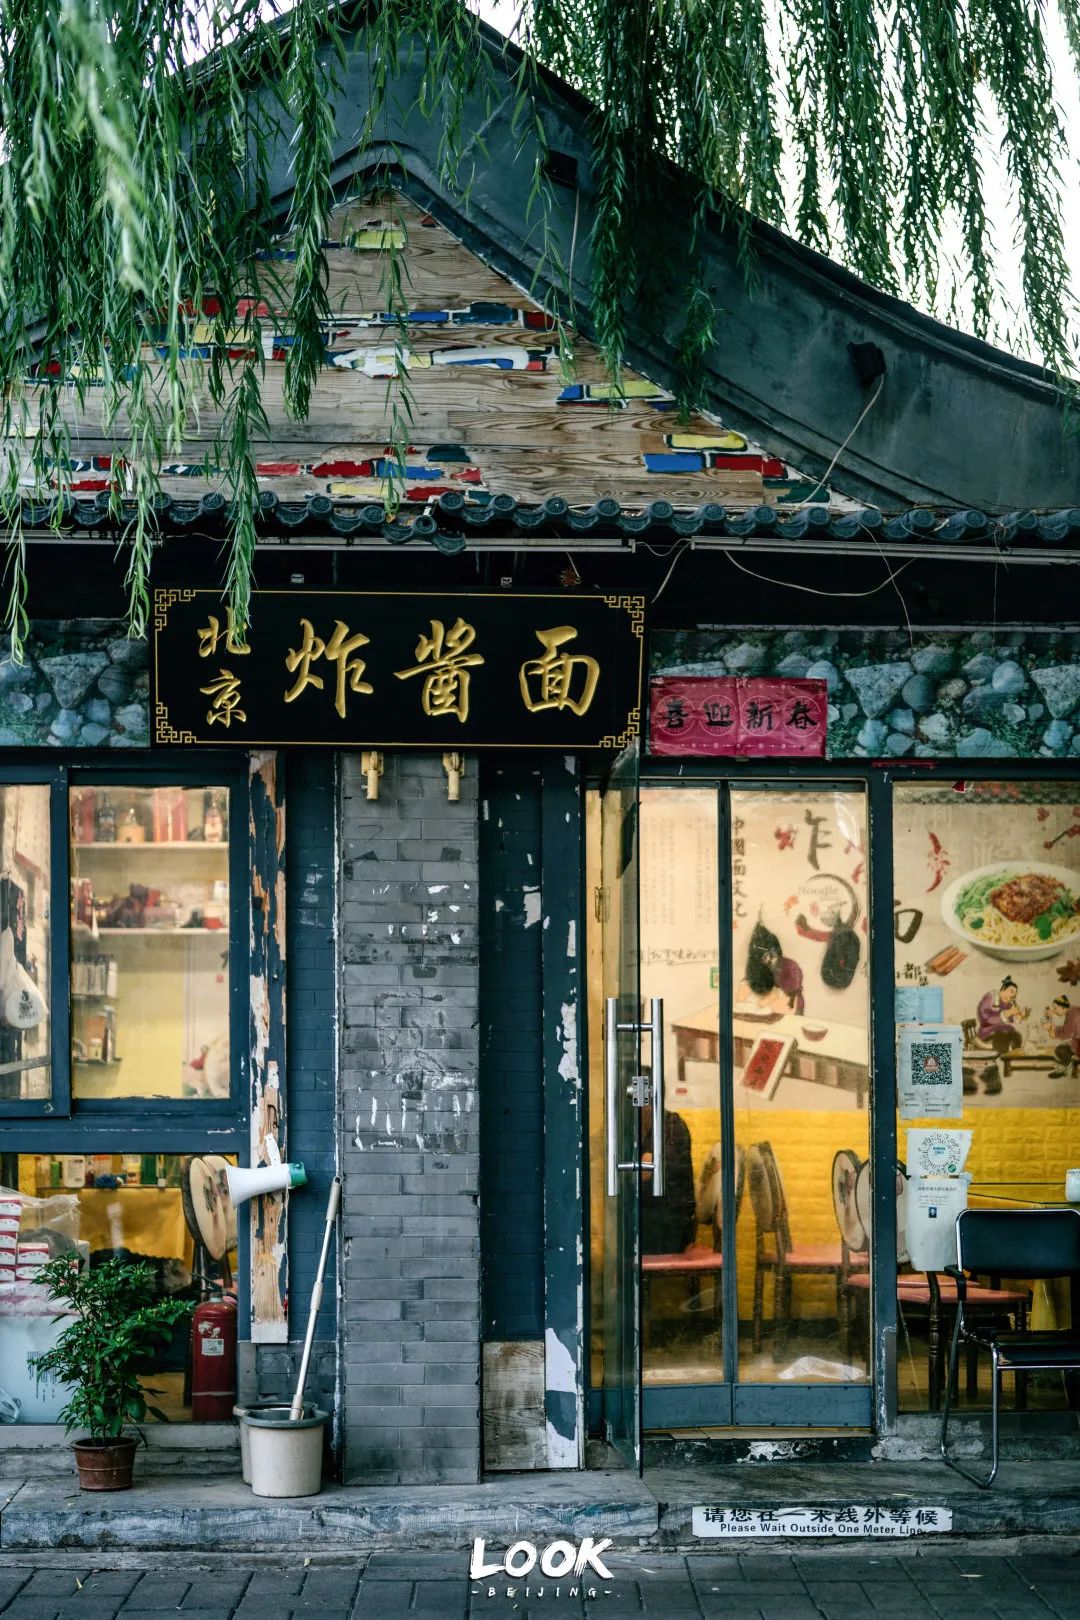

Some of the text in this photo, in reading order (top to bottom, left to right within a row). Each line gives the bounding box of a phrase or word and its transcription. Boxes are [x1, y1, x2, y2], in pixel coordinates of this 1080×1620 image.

[197, 606, 251, 728] 北京
[720, 1523, 756, 1532] Please
[761, 1523, 786, 1532] Wait
[790, 1523, 834, 1533] Outside
[838, 1525, 859, 1533] One
[863, 1525, 895, 1534] Meter
